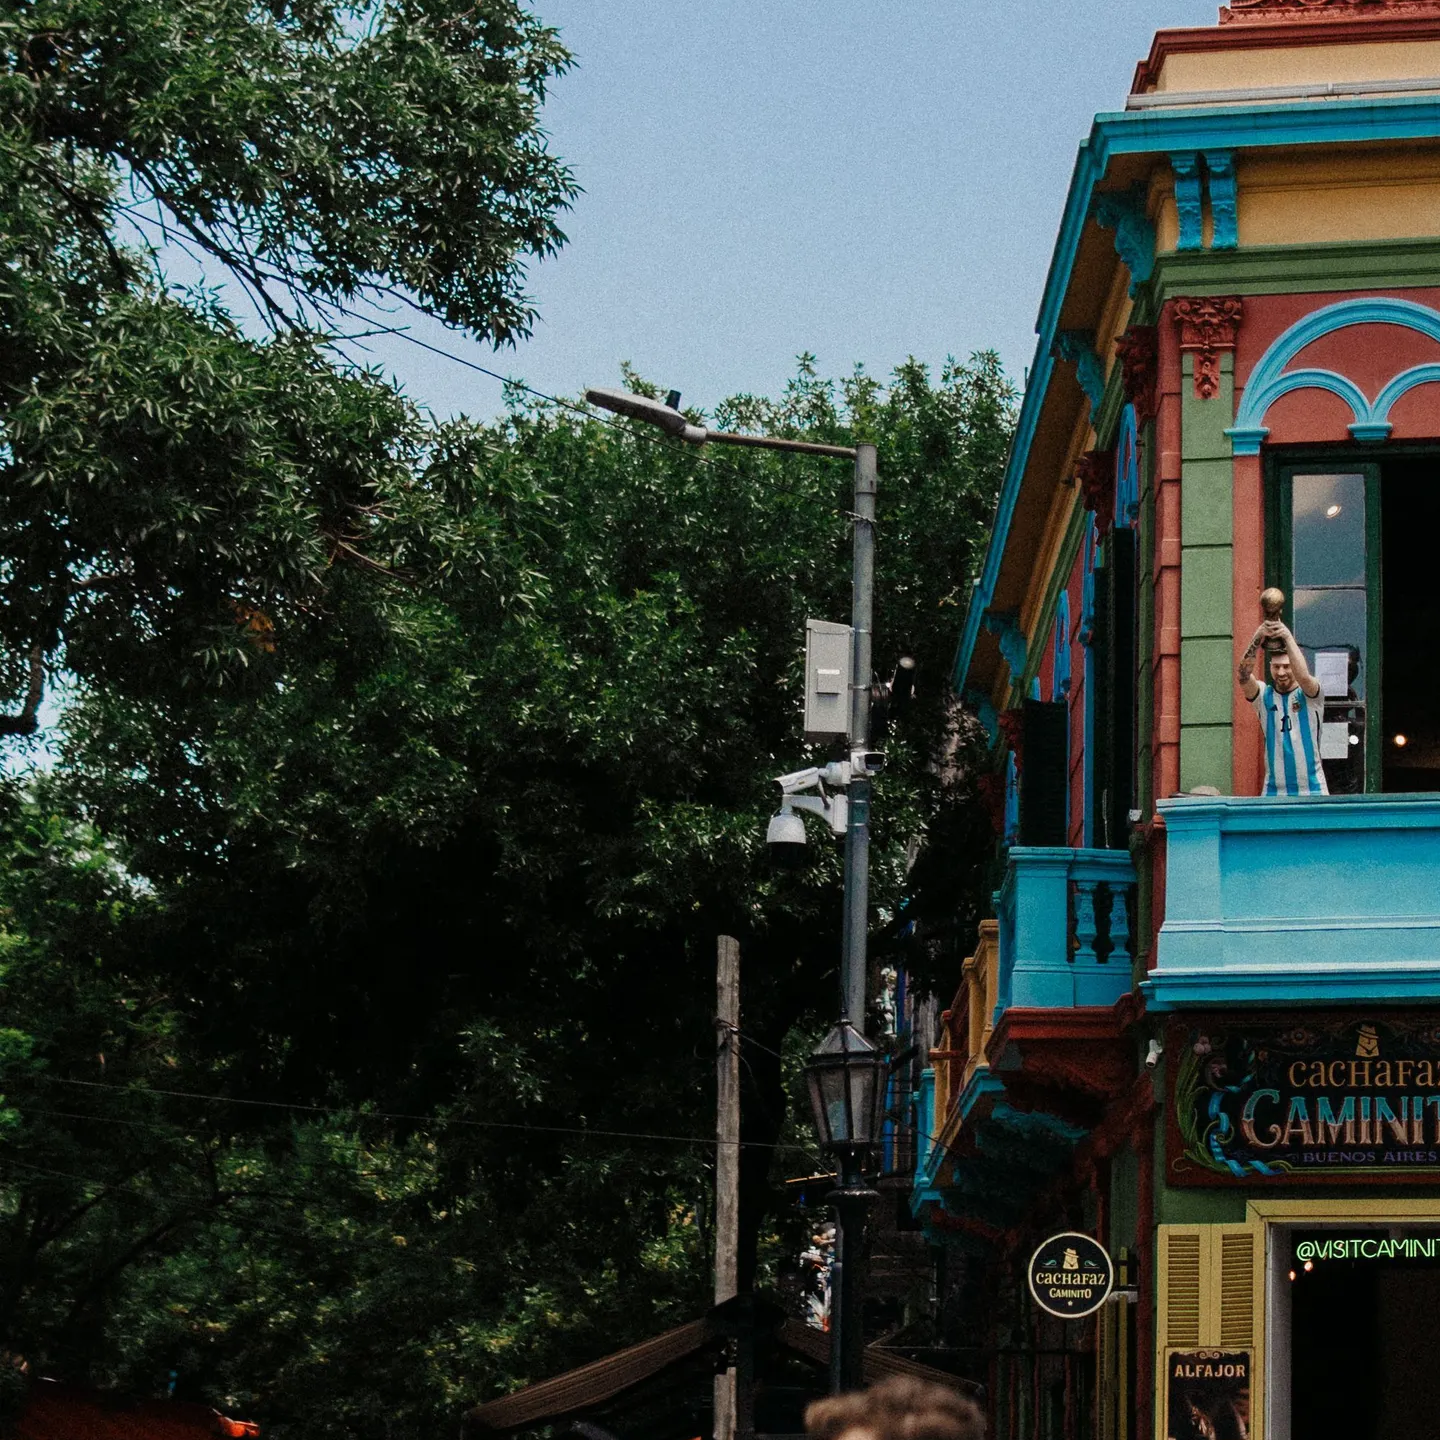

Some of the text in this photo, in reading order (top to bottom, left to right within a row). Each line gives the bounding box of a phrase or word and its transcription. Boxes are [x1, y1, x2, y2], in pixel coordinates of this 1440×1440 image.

[1281, 714, 1292, 732] 10
[1302, 1151, 1437, 1163] BUENOS AIRES
[1049, 1288, 1092, 1299] CAMINITO
[1174, 1364, 1246, 1377] ALFAJOR
